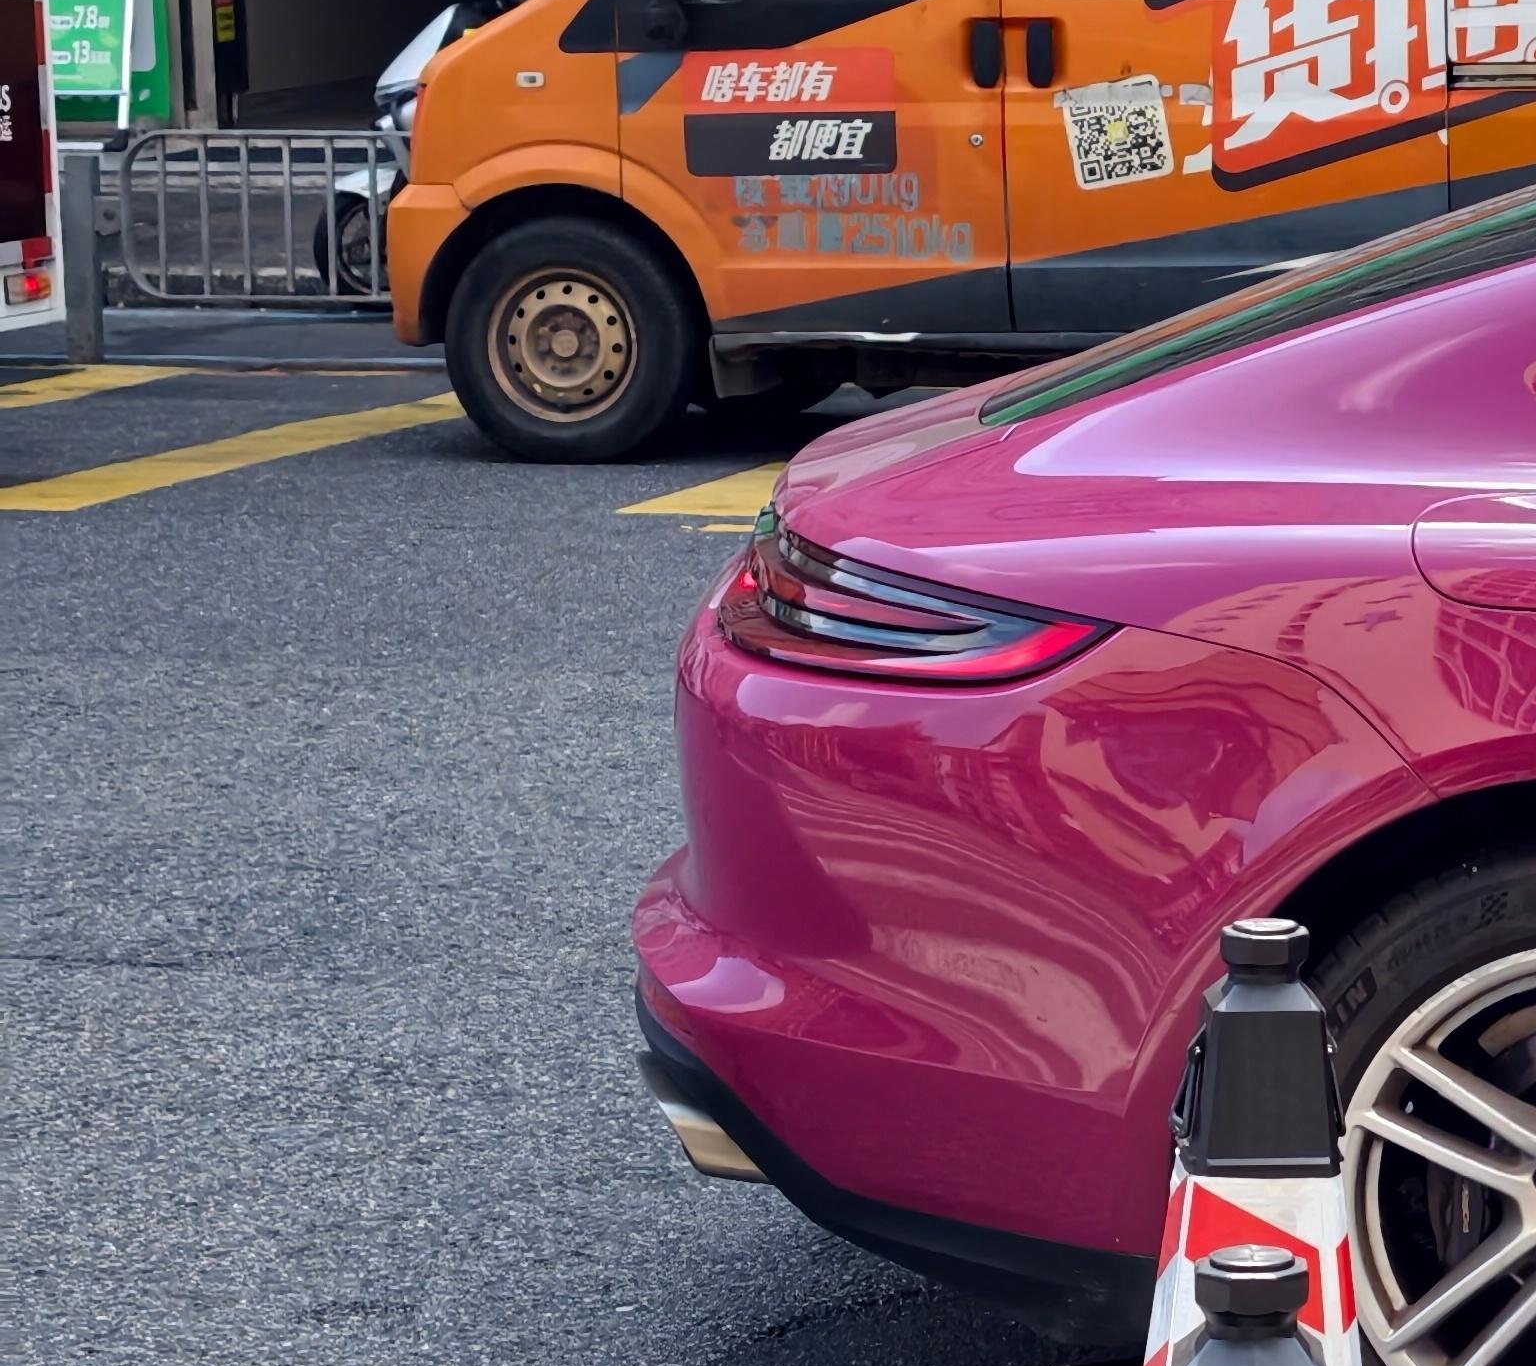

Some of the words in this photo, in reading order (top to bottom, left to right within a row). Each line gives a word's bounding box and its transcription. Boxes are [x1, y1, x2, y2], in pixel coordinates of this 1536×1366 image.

[701, 60, 838, 103] 啥车都有
[768, 118, 873, 161] 都便宜
